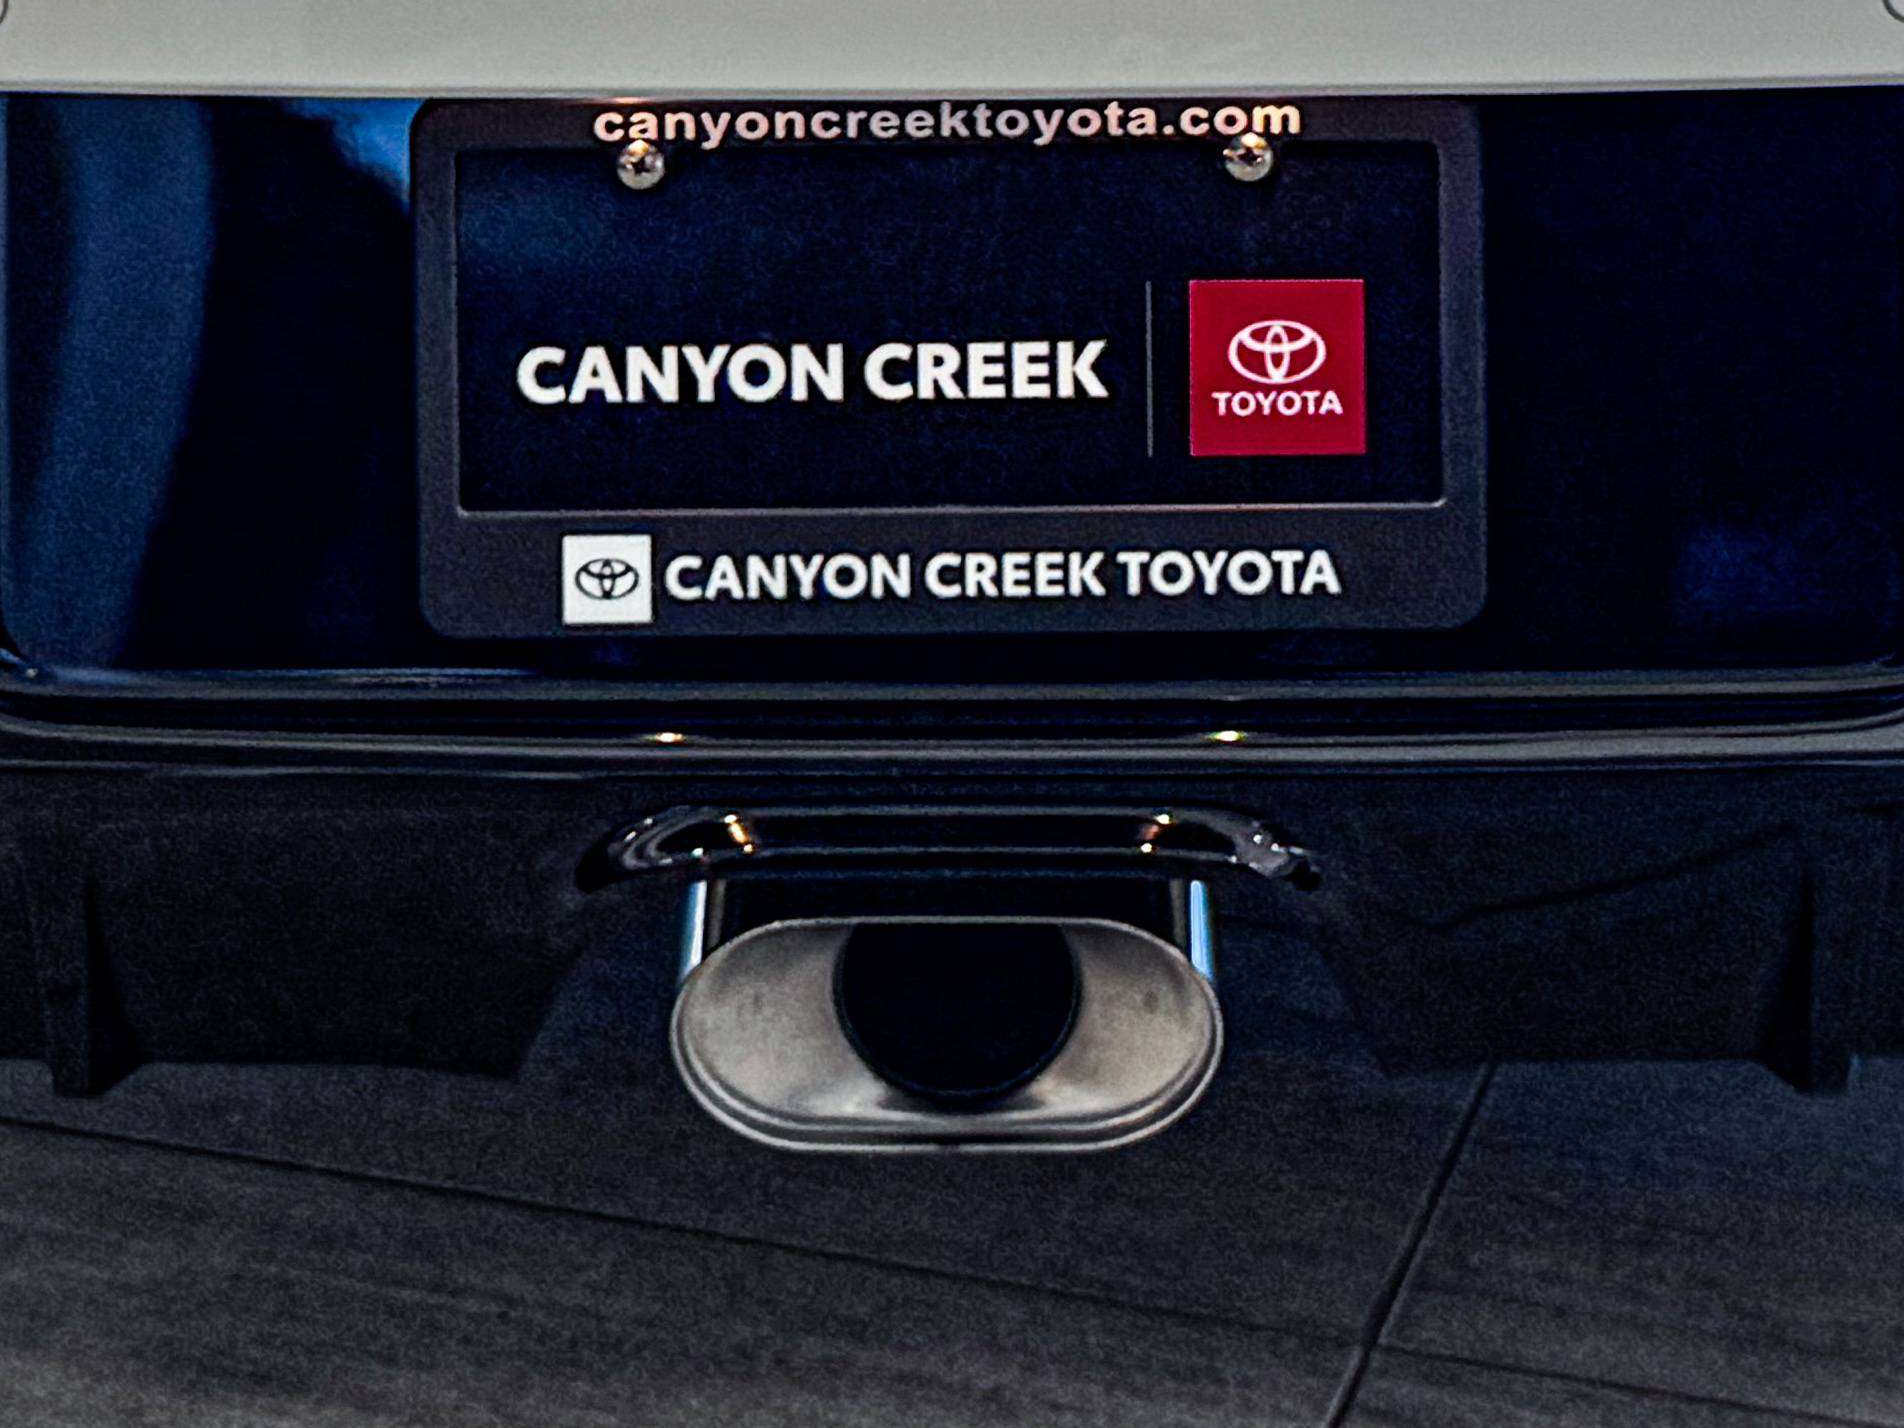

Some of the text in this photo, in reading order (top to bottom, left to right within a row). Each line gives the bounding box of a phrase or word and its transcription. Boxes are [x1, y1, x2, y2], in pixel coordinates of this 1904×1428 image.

[593, 100, 1302, 150] canyoncreektoyota.com
[516, 339, 1109, 405] CANYON CREEK
[1211, 390, 1344, 417] TOYOTA
[664, 549, 1342, 601] CANYON CREEK TOYOTA
